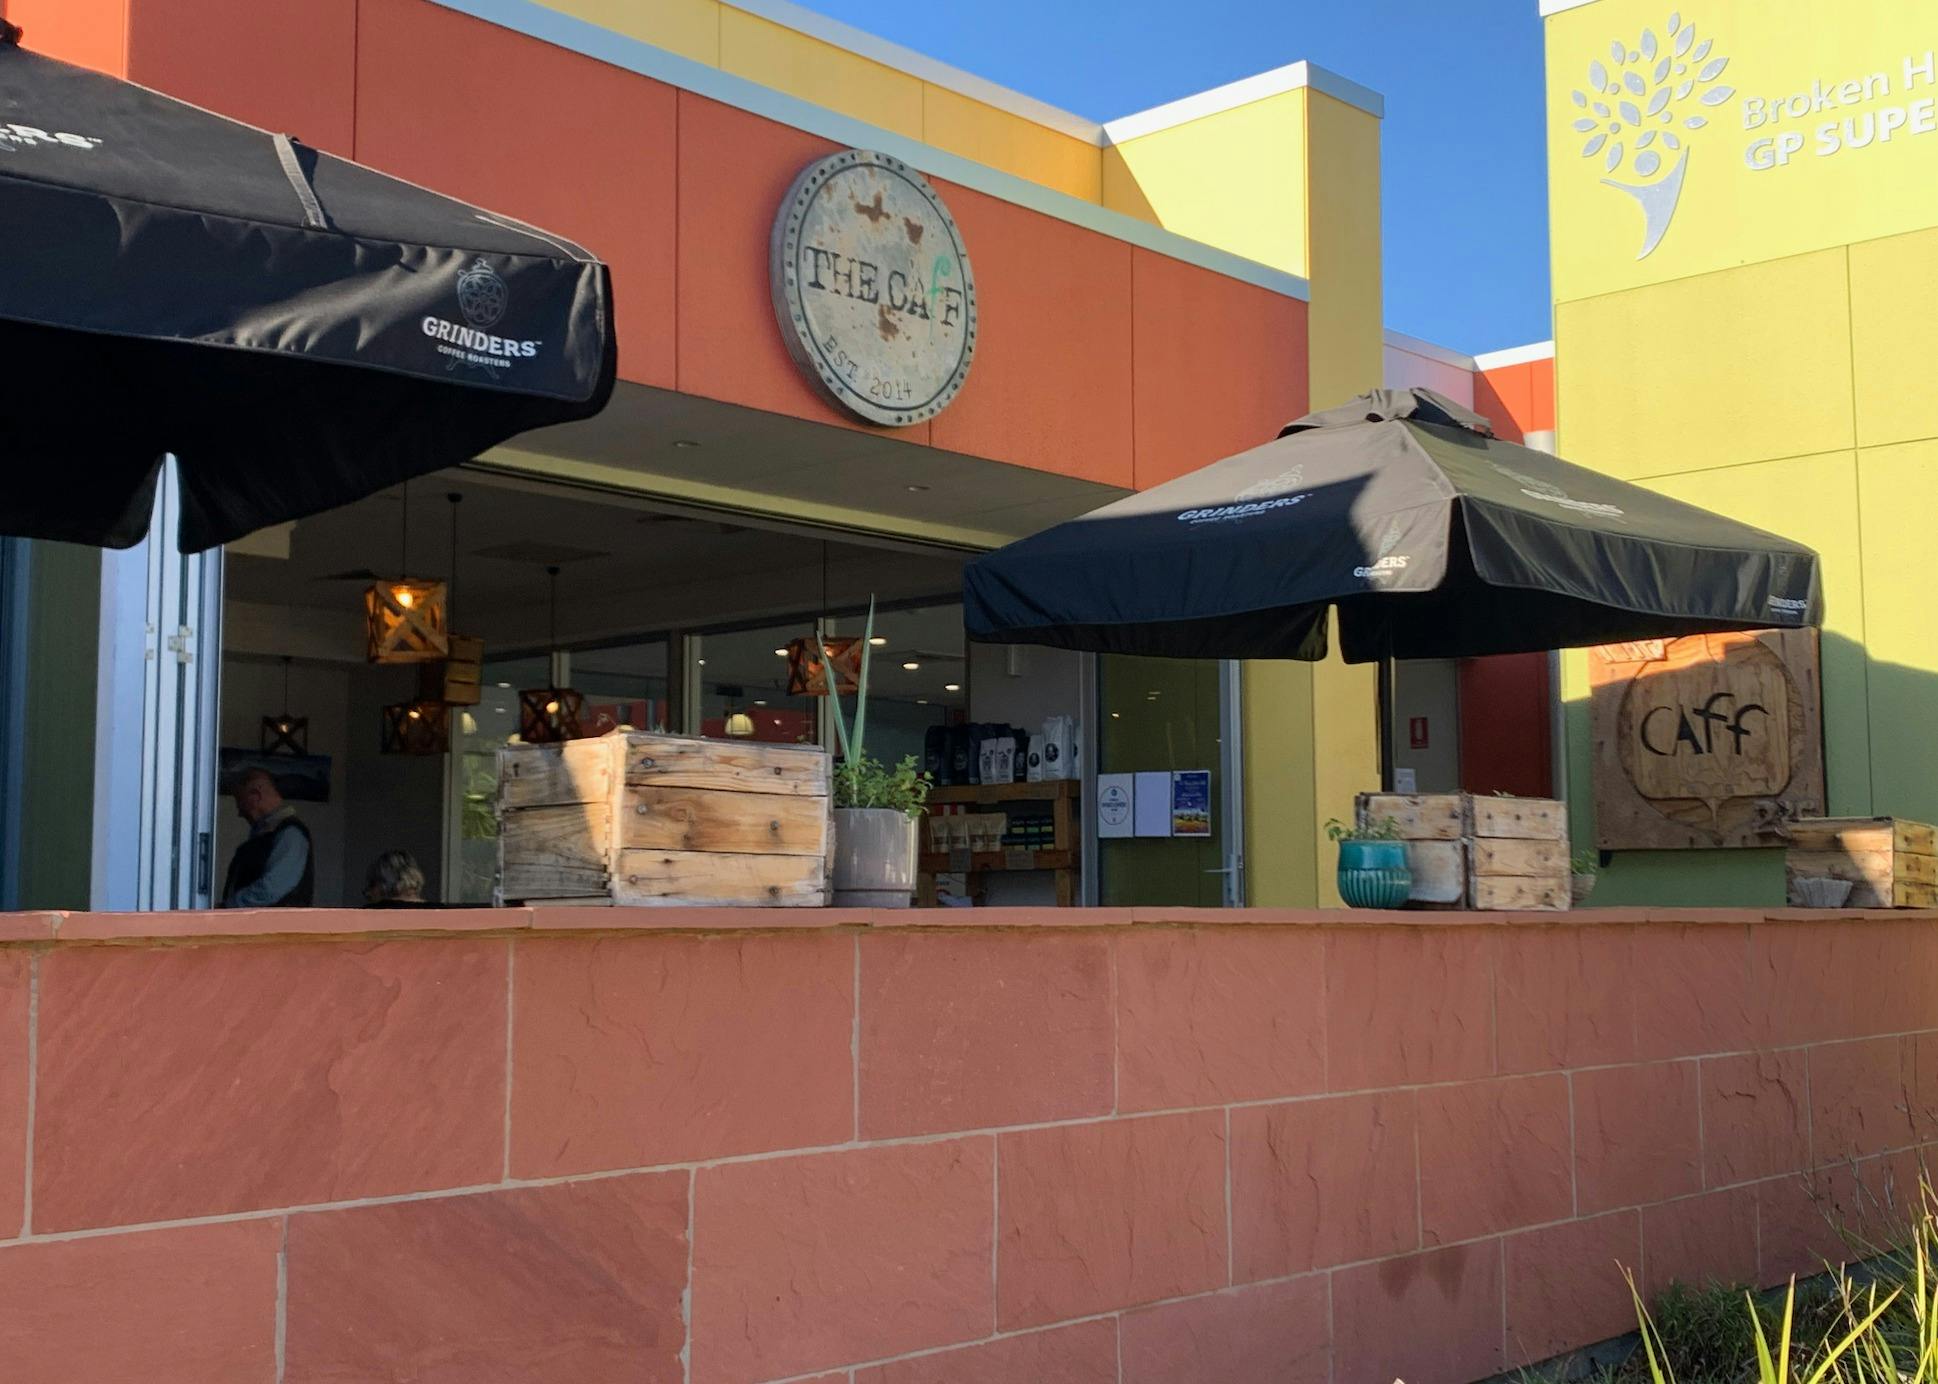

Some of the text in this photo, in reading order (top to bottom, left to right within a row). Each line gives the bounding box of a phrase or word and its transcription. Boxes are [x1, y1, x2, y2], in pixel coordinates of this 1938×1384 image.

[1743, 72, 1890, 131] Broken
[1744, 98, 1937, 171] GP SUPE
[804, 246, 879, 305] THE
[422, 316, 537, 357] GRINDERS
[870, 376, 912, 401] 2014
[1177, 494, 1306, 521] GRINDERS
